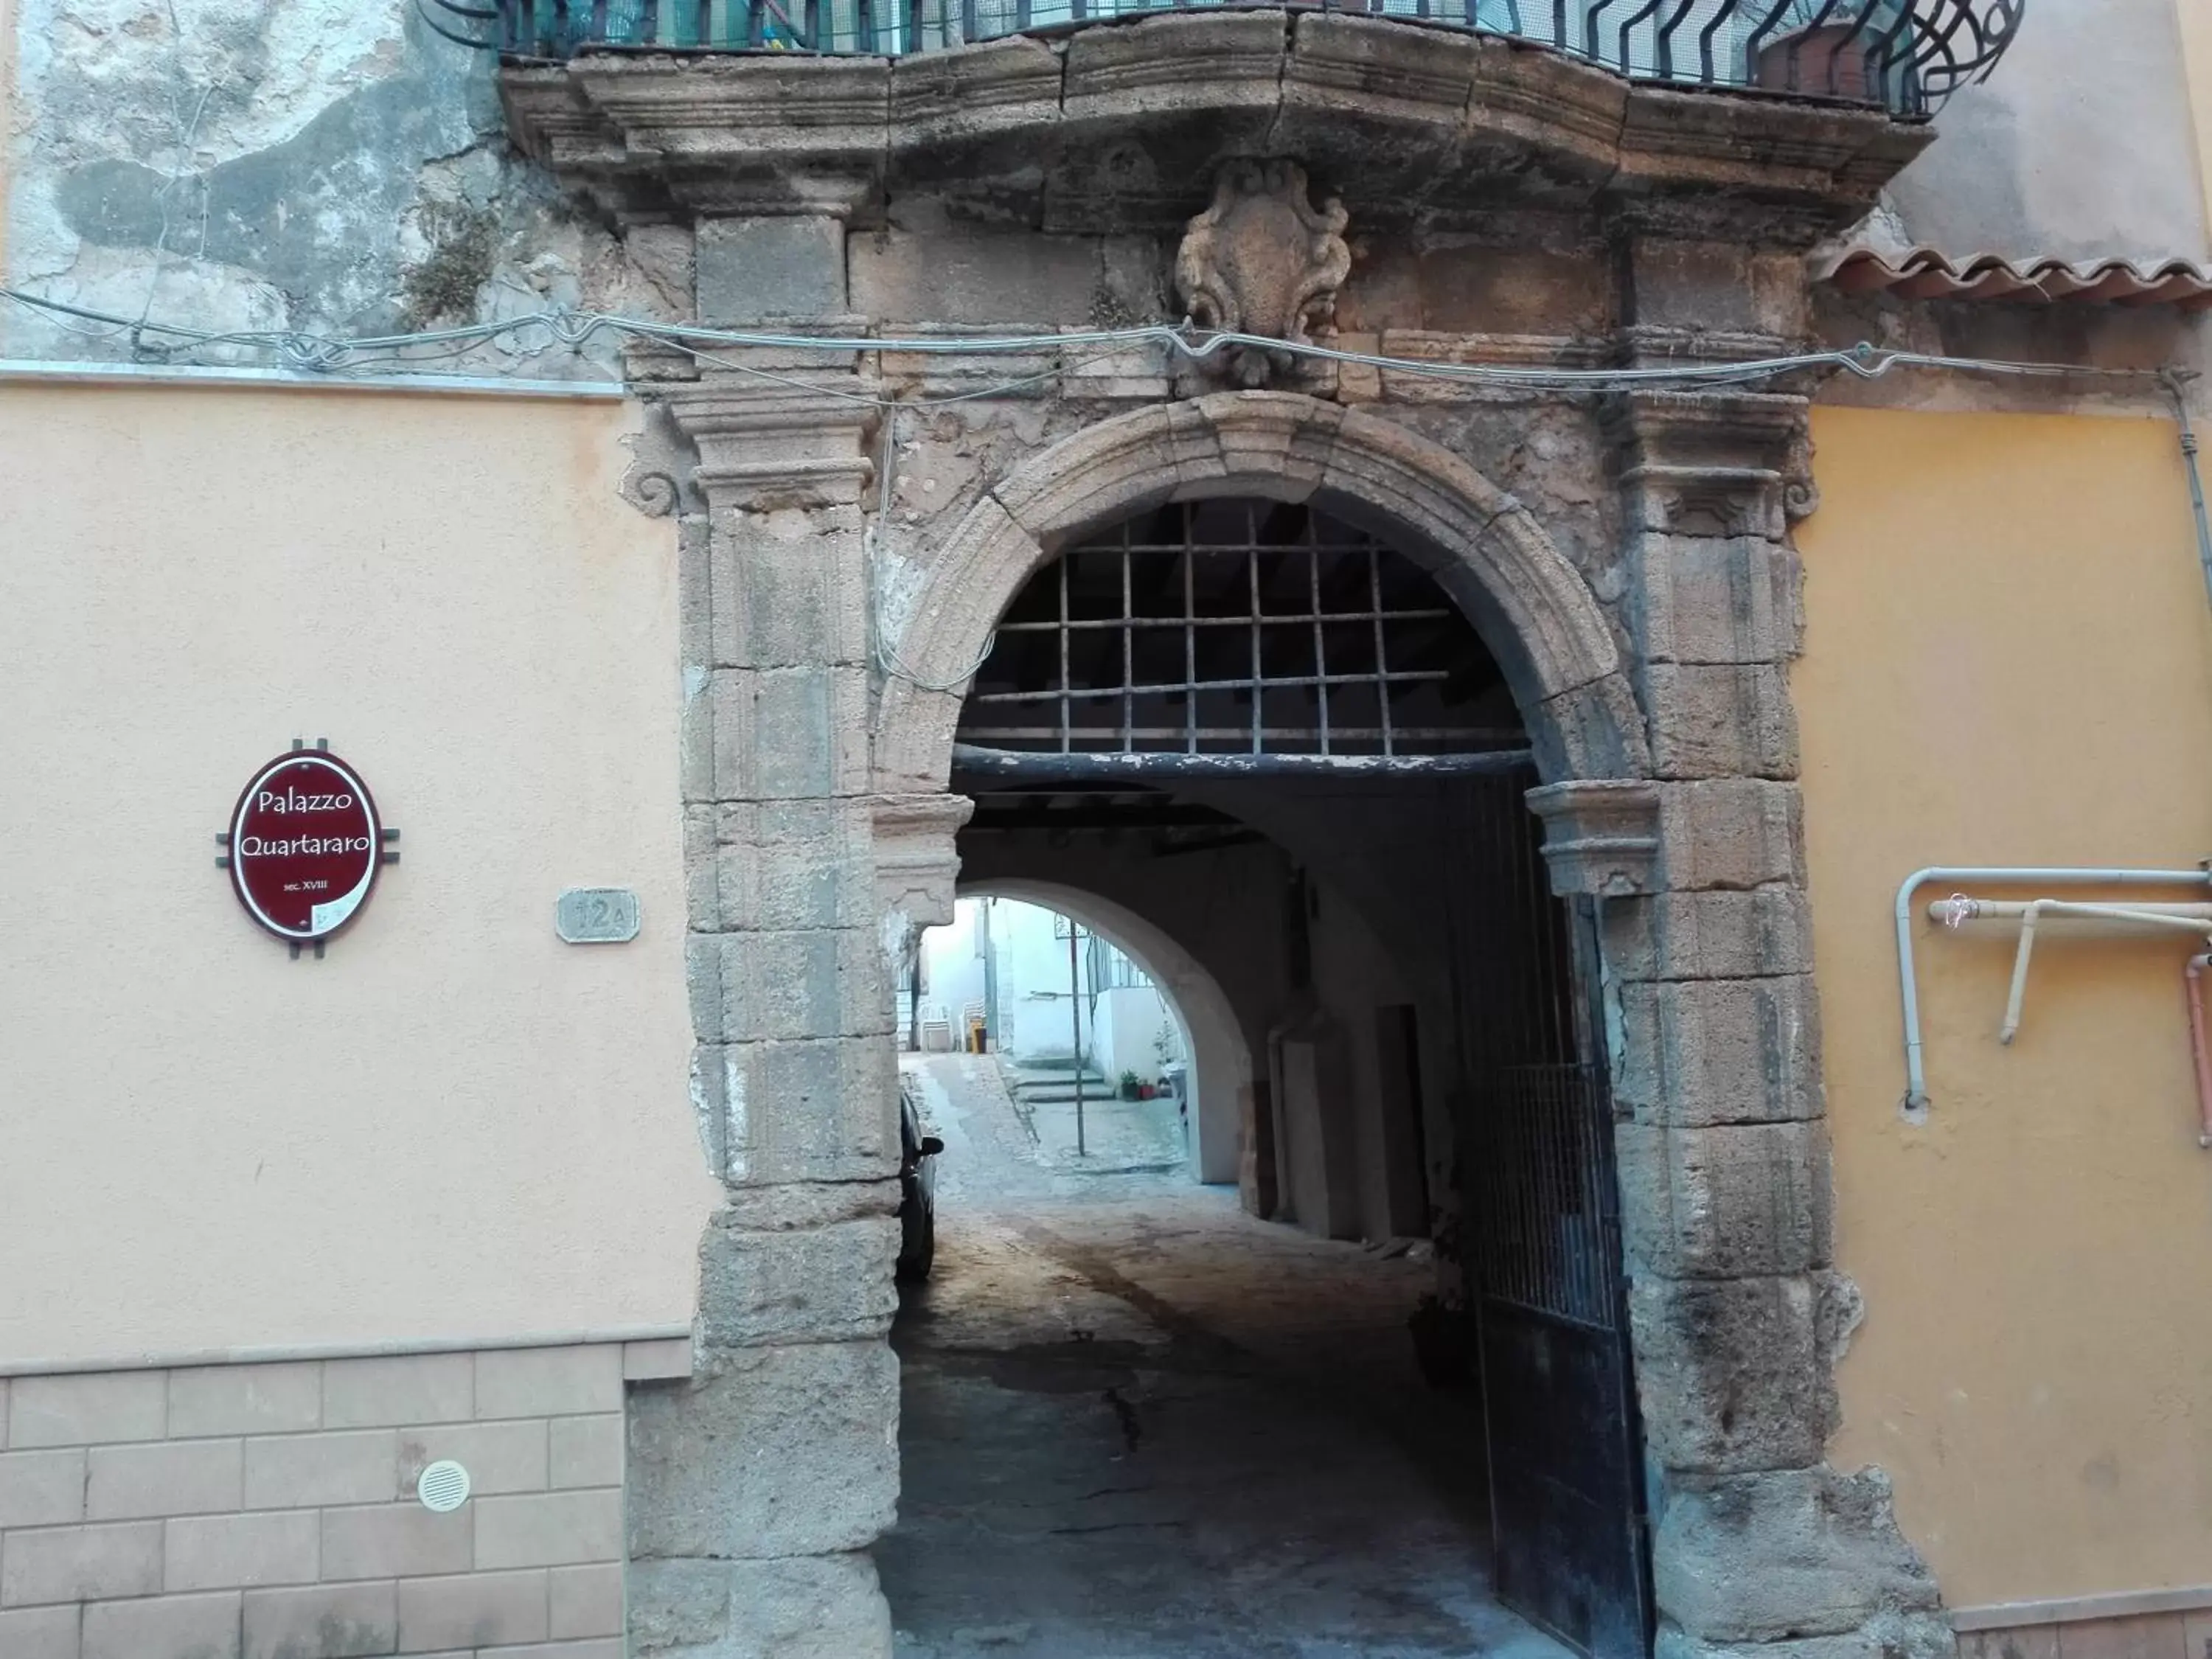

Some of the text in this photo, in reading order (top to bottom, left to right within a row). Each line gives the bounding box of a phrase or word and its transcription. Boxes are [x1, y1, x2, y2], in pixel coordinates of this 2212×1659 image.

[260, 786, 352, 813] Palazzo
[241, 835, 369, 857] Quartararo
[302, 880, 327, 891] XVIII
